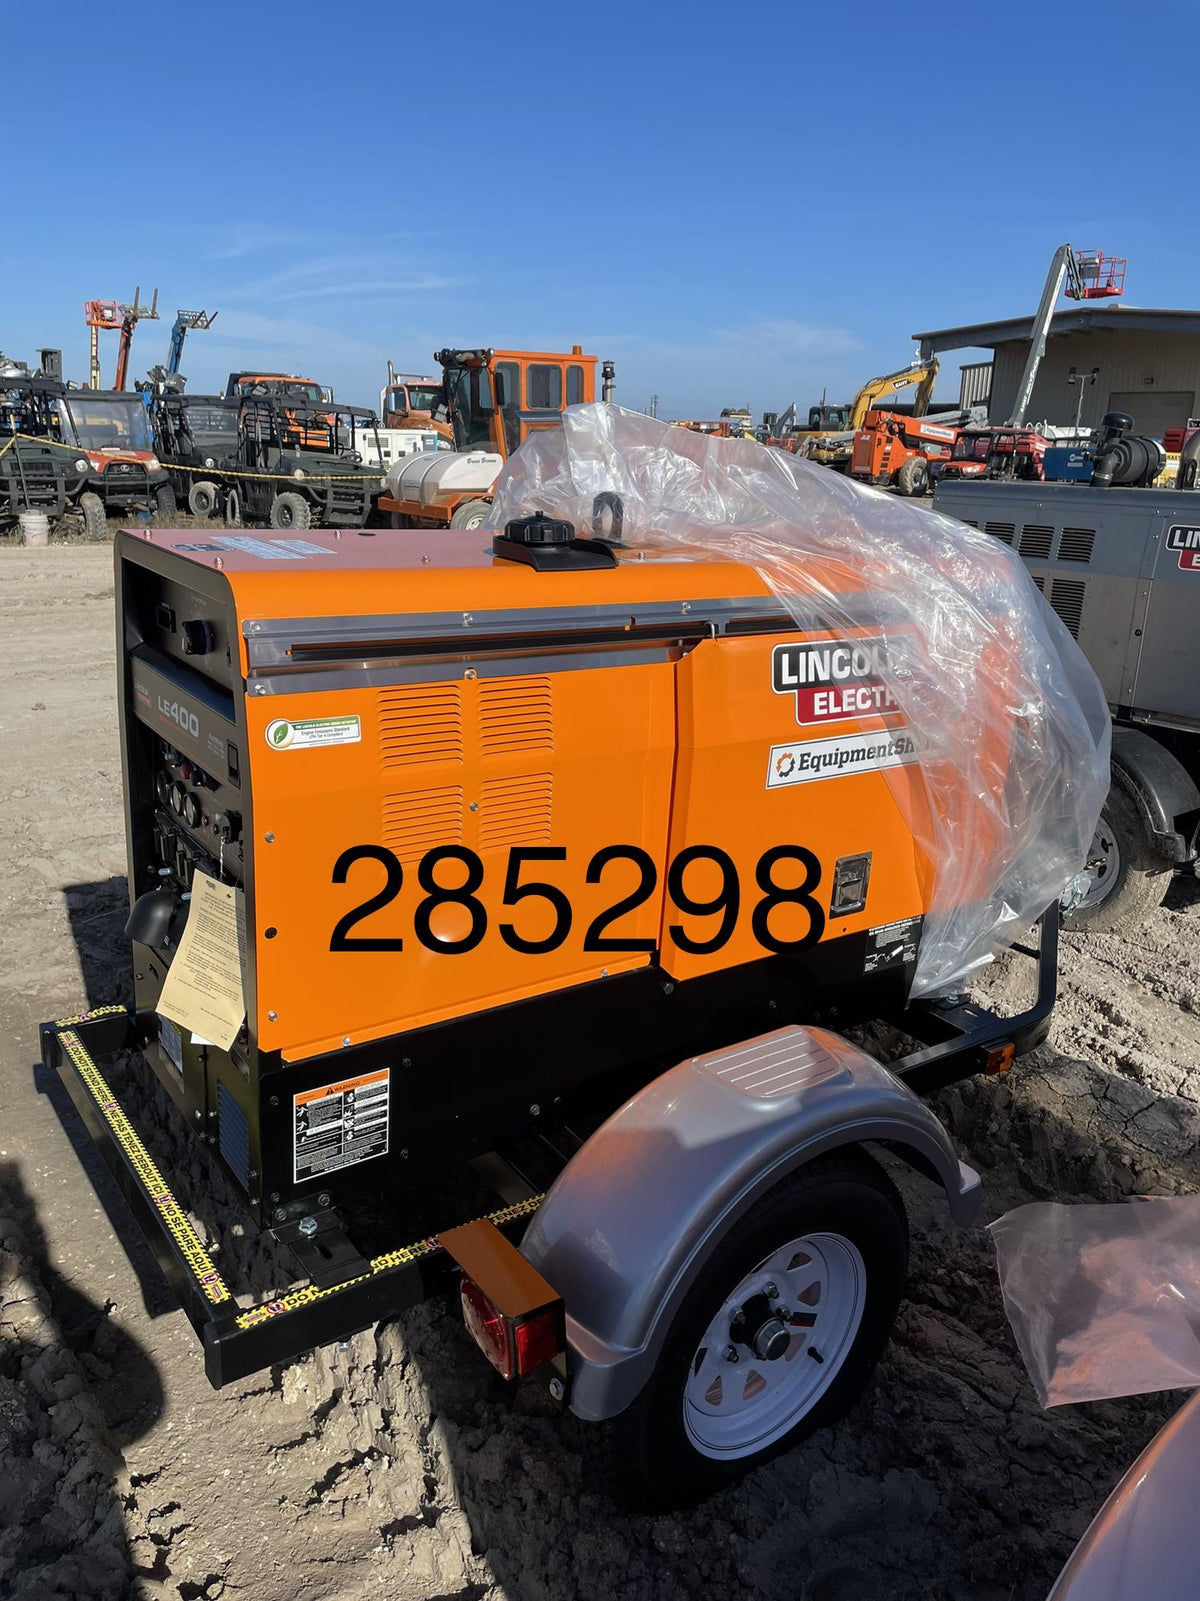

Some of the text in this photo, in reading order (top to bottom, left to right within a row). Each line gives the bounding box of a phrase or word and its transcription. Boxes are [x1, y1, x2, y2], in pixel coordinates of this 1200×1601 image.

[781, 645, 887, 685] LINCOL
[814, 685, 899, 716] ELECTR
[158, 695, 199, 738] LE400
[798, 738, 914, 772] EquipmentSh
[71, 1047, 110, 1104] DO NOT STAND HERE
[334, 1081, 360, 1092] WARNING
[109, 1109, 165, 1195] NE PAS TENEZ DEBOUT ICI
[164, 1204, 177, 1216] NO
[491, 1205, 527, 1221] ENEZ
[171, 1217, 184, 1229] SE
[177, 1228, 198, 1252] PARE
[390, 1244, 427, 1262] HERE
[286, 1293, 309, 1306] DO
